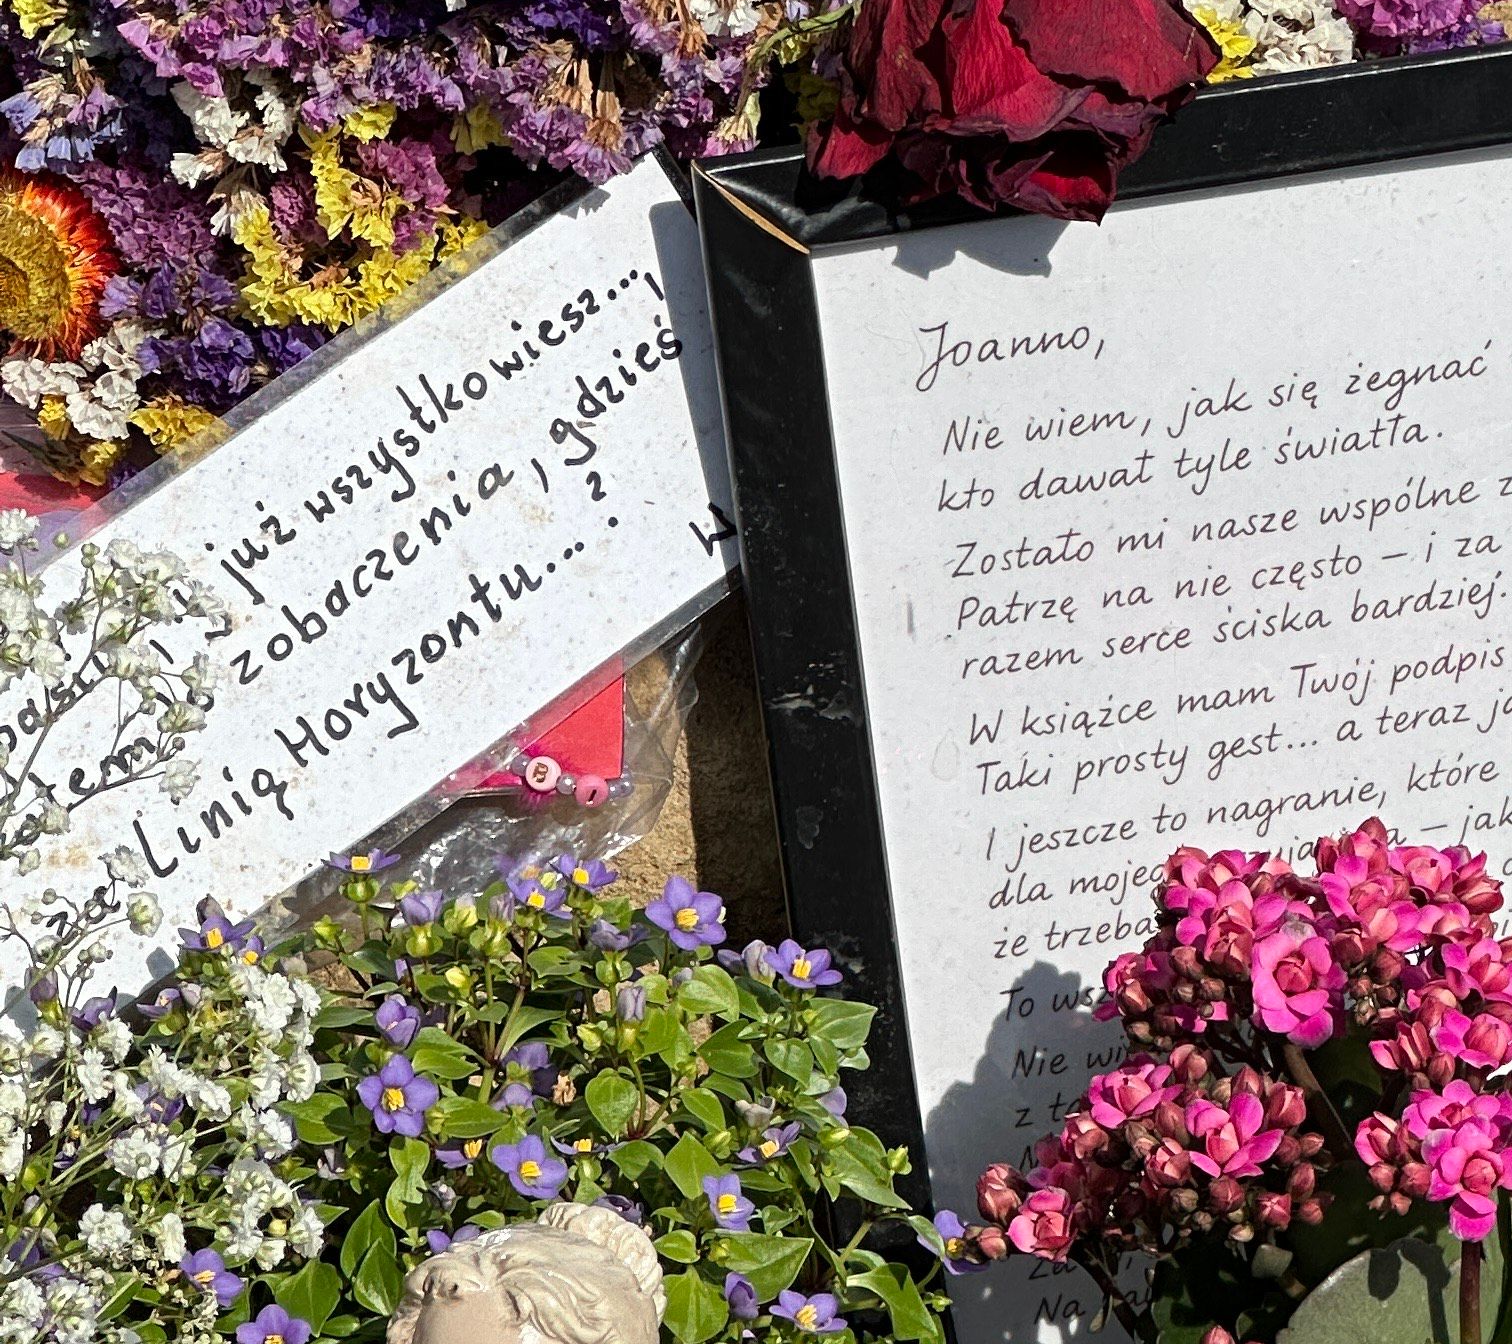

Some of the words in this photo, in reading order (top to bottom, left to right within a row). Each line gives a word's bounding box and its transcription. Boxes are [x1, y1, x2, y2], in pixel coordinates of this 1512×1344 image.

[550, 314, 684, 466] gdzieś
[916, 321, 1104, 392] Joanno,
[943, 416, 1004, 455] Nie
[1025, 408, 1151, 441] wiem,
[1167, 378, 1252, 438] jak
[1268, 372, 1317, 409] się
[1345, 339, 1492, 411] żegnać
[938, 478, 994, 512] kto
[1019, 449, 1155, 500] dawał
[1174, 438, 1251, 495] tyle
[1275, 413, 1442, 464] światła.
[205, 500, 296, 606] już
[950, 528, 1094, 578] Zostało
[1117, 518, 1168, 553] mi
[1192, 509, 1298, 541] nasze
[1320, 476, 1480, 531] wspólne
[958, 590, 1078, 630] Patrzę
[1103, 586, 1153, 608] na
[1175, 565, 1231, 599] nie
[1252, 544, 1362, 591] często
[1426, 531, 1436, 563] i
[1455, 536, 1502, 557] za
[962, 648, 1083, 679] razem
[1102, 628, 1192, 658] serce
[1213, 602, 1331, 643] ściska
[1351, 571, 1506, 622] bardziej.
[970, 709, 1003, 745] W
[1021, 694, 1157, 738] książce
[1177, 687, 1275, 714] mam
[1290, 658, 1374, 706] Twój
[1390, 638, 1504, 695] podpis
[976, 752, 1053, 795] Taki
[1072, 739, 1188, 794] prosty
[1208, 722, 1317, 782] gest...
[1337, 720, 1363, 741] a
[1376, 704, 1470, 735] teraz
[133, 766, 294, 877] Linią
[1005, 820, 1137, 873] jeszcze
[1152, 803, 1187, 834] to
[1207, 777, 1389, 837] nagranie,
[1408, 752, 1500, 809] które
[989, 872, 1053, 909] dla
[994, 926, 1028, 959] że
[1000, 987, 1034, 1020] To
[1012, 1047, 1067, 1080] Nie
